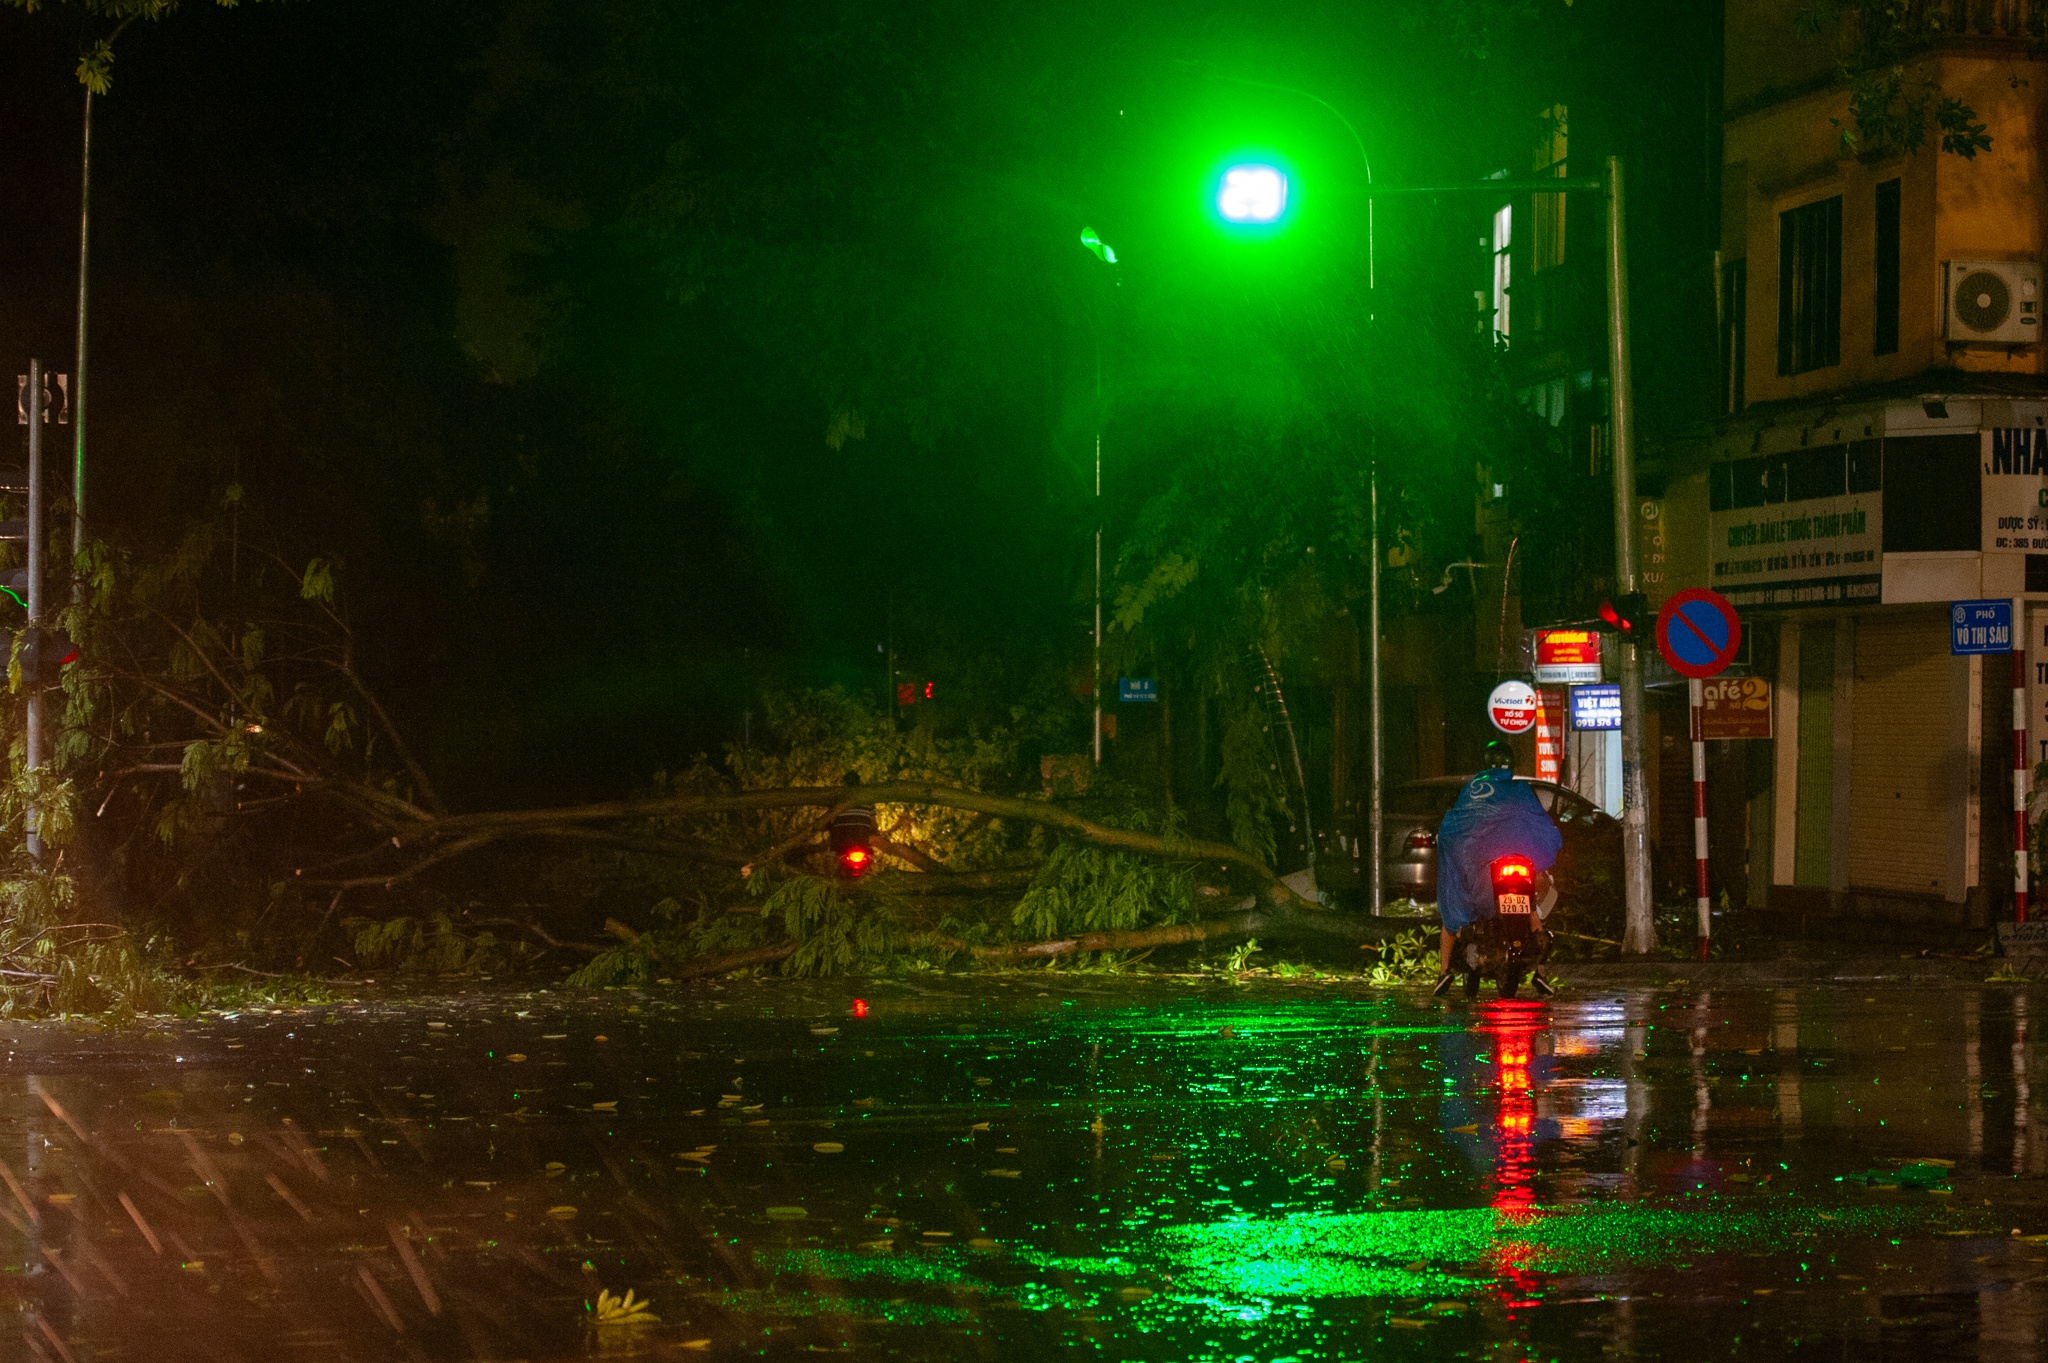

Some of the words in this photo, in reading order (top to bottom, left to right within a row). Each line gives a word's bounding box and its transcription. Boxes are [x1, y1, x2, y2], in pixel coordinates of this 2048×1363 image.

[1993, 416, 2048, 475] NHÀ
[1998, 516, 2023, 532] DƯỢC
[1976, 606, 1995, 619] PHỐ
[1957, 624, 1969, 645] VÕ
[1971, 627, 1986, 648] THỊ
[1989, 622, 2008, 644] SÁU
[1704, 680, 1741, 700] afé
[1742, 678, 1769, 711] 2
